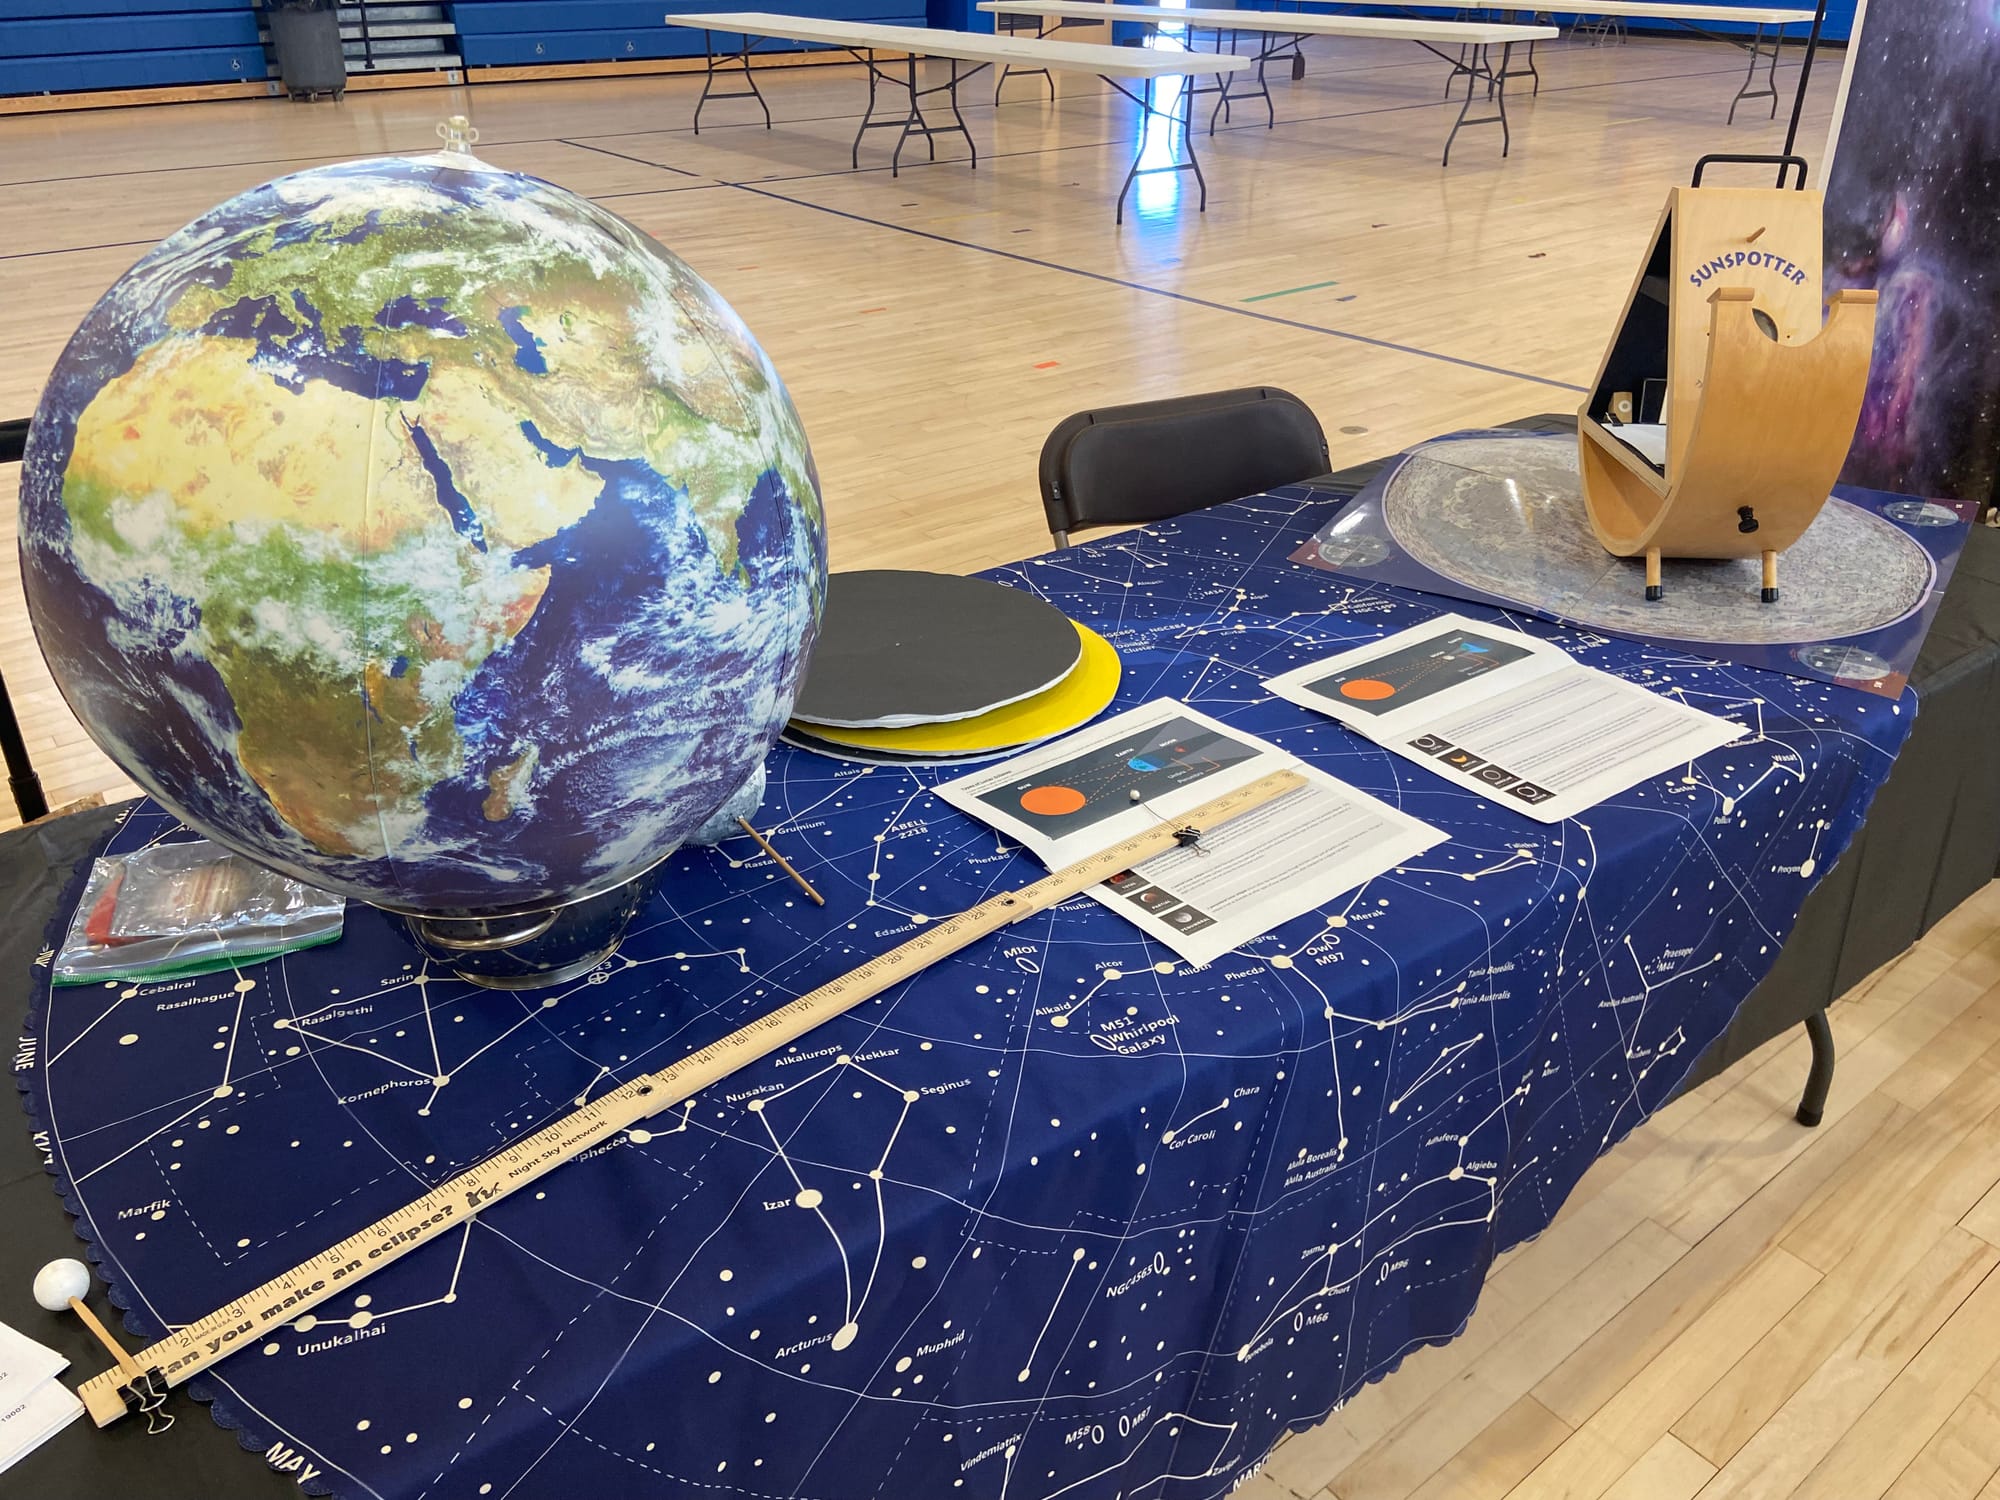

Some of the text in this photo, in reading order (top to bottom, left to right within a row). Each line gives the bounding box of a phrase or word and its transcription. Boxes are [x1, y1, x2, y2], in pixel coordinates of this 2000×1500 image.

[1690, 250, 1806, 288] SUNSPOTTER
[1116, 640, 1150, 649] Double
[1123, 645, 1155, 654] Cluster
[834, 768, 860, 778] Altais
[777, 821, 826, 835] Grumium
[891, 819, 928, 833] ABELL
[900, 826, 928, 840] 2218
[744, 855, 793, 869] Rastan
[968, 853, 1010, 865] Pherkad
[1060, 901, 1099, 912] Thuban
[1350, 909, 1386, 922] Merak
[874, 923, 917, 938] Edasich
[1307, 942, 1333, 956] Owl
[1095, 960, 1124, 971] Alcor
[1315, 952, 1345, 967] M97
[380, 973, 414, 986] Sarin
[1224, 966, 1265, 982] Phecda
[139, 980, 197, 996] Cebalrai
[156, 991, 235, 1012] Rasalhague
[1035, 1002, 1073, 1017] Alkaid
[301, 1004, 374, 1027] Rasalgethi
[1100, 1016, 1134, 1032] M51
[1107, 1014, 1180, 1043] Whirlpool
[1117, 1033, 1166, 1055] Galaxy
[15, 1036, 37, 1072] JUNE
[774, 1044, 843, 1067] Alkalurops
[854, 1047, 900, 1063] Nekkar
[337, 1076, 431, 1105] Kornephoros
[725, 1082, 785, 1103] Nusakan
[920, 1077, 972, 1096] Seginus
[1233, 1085, 1260, 1099] Chara
[179, 1337, 192, 1348] 2
[231, 1308, 243, 1318] 3
[281, 1280, 293, 1290] 4
[329, 1253, 341, 1264] 5
[376, 1227, 388, 1238] 6
[421, 1202, 432, 1212] 7
[465, 1178, 477, 1188] 8
[508, 1154, 519, 1165] 9
[545, 1132, 560, 1143] 10
[582, 1110, 598, 1122] 11
[620, 1090, 635, 1101] 12
[661, 1072, 677, 1084] 13
[697, 1055, 712, 1066] 14
[732, 1036, 747, 1047] 15
[764, 1018, 779, 1029] 16
[796, 1002, 811, 1013] 17
[827, 985, 843, 996] 18
[857, 970, 873, 981] 19
[887, 955, 903, 965] 20
[916, 939, 931, 950] 21
[943, 925, 959, 936] 22
[1169, 1129, 1216, 1150] Cor Caroli
[508, 1119, 609, 1179] Night Sky Network
[1305, 1147, 1338, 1164] Borealis
[1304, 1162, 1338, 1181] Australis
[1465, 1160, 1498, 1172] Algieba
[117, 1198, 172, 1220] Marfik
[762, 1198, 791, 1212] Izar
[205, 1319, 255, 1355] you
[260, 1278, 326, 1321] make
[332, 1257, 363, 1281] an
[368, 1204, 454, 1260] eclipse?
[1106, 1265, 1154, 1299] NGC4565
[1306, 1312, 1329, 1326] M66
[297, 1322, 386, 1356] Unukalhai
[774, 1332, 833, 1359] Arcturus
[916, 1328, 965, 1357] Muphrid
[1, 1404, 27, 1423] 19002
[1131, 1405, 1152, 1429] M87
[1064, 1425, 1091, 1446] M58
[960, 1432, 1022, 1472] Vindemiatrix
[265, 1441, 322, 1486] MAY
